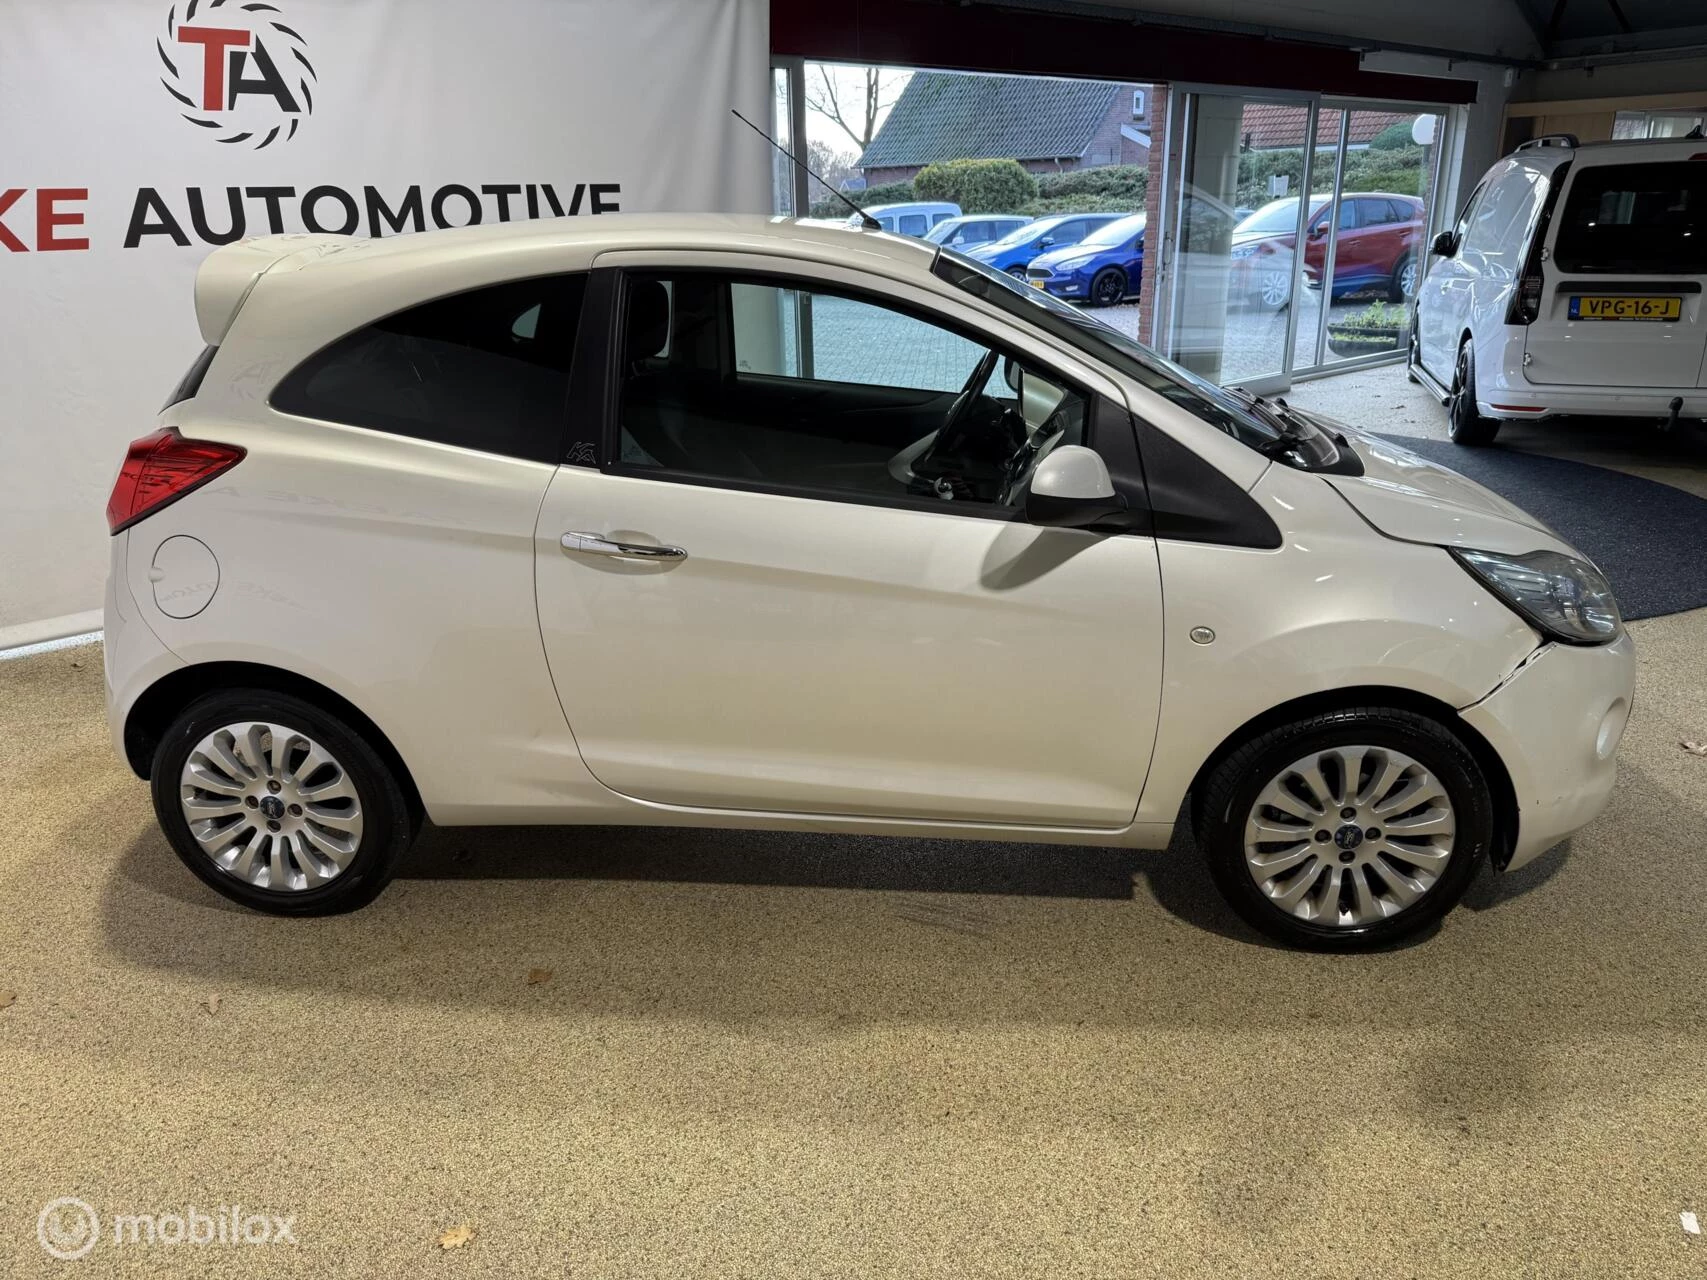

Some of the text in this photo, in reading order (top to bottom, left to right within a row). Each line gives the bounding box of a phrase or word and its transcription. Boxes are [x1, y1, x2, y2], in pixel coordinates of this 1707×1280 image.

[178, 26, 302, 112] TA
[123, 183, 621, 248] AUTOMOTIVE
[1589, 300, 1670, 315] VPG-16-J
